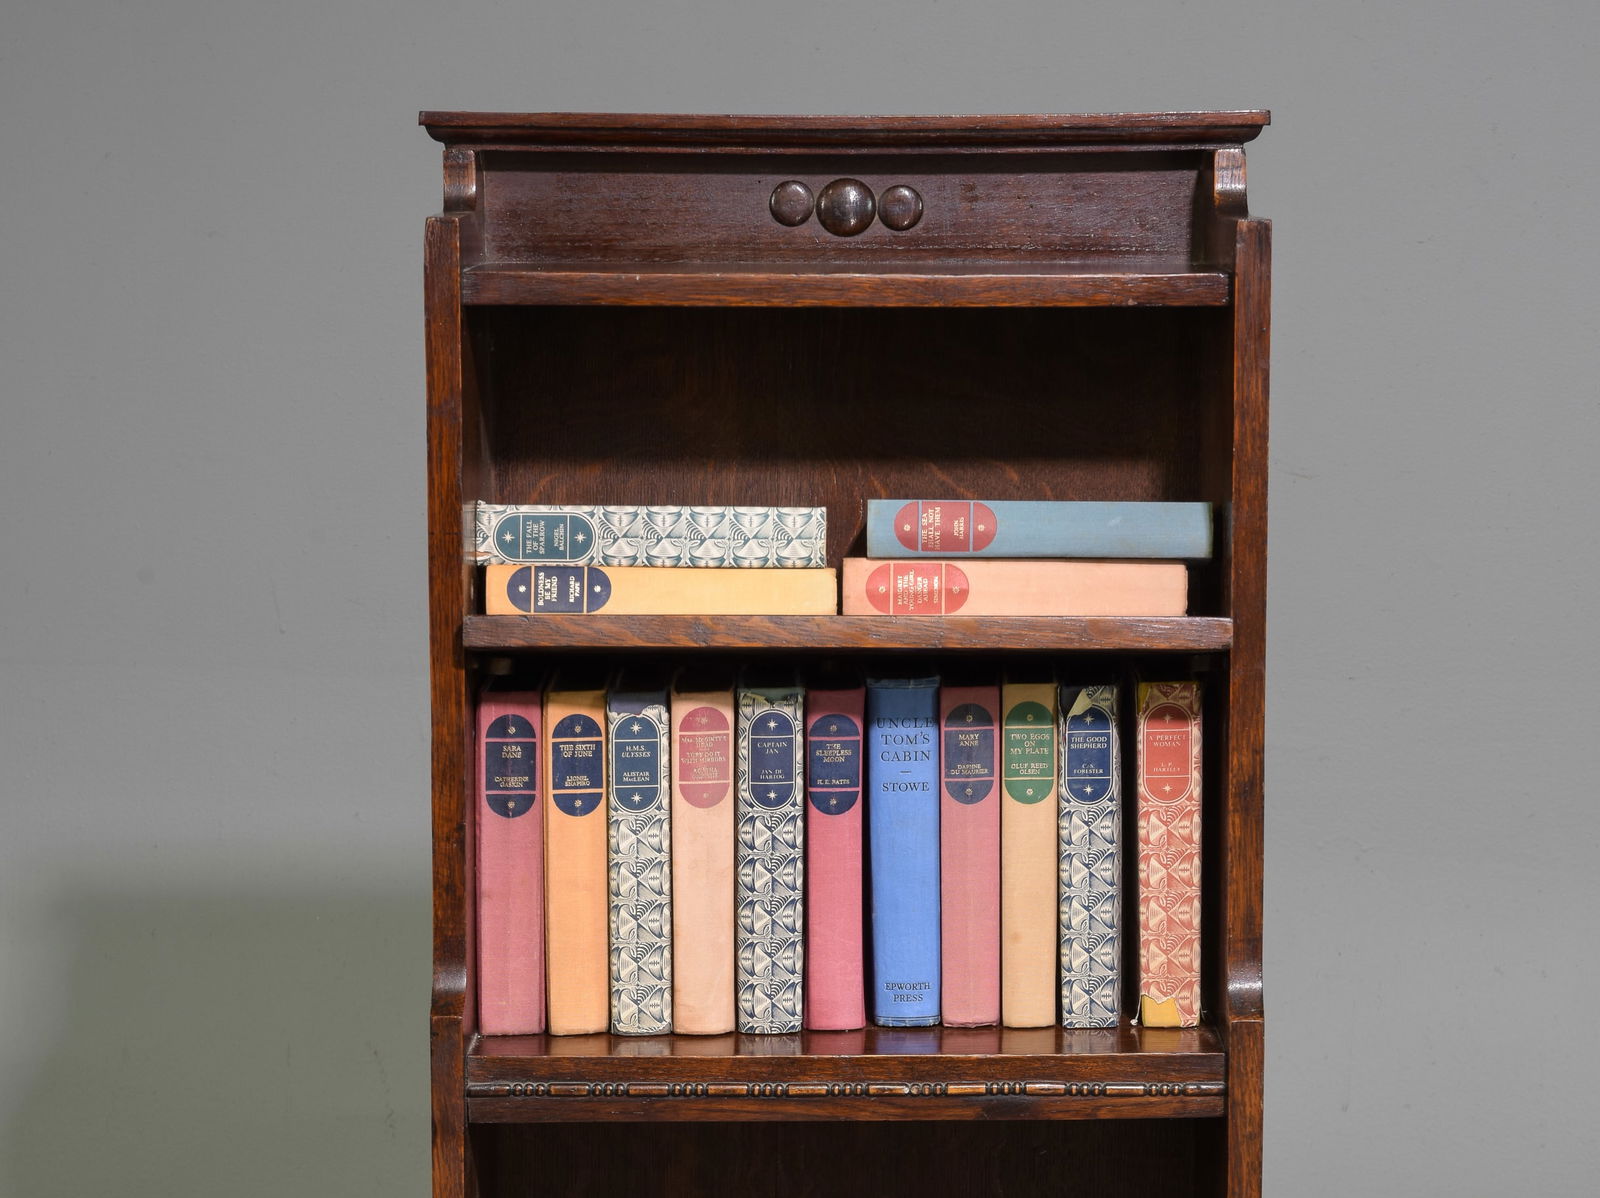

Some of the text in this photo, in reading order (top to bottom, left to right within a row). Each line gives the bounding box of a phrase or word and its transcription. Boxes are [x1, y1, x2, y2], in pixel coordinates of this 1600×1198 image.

[532, 541, 538, 550] OF
[545, 578, 551, 600] BE MY
[876, 717, 934, 728] UNCLE
[881, 731, 930, 745] TOM'S
[881, 750, 930, 761] CABIN
[882, 782, 929, 792] STOWE
[885, 982, 930, 990] EPWORTH
[893, 994, 923, 1002] PRESS
